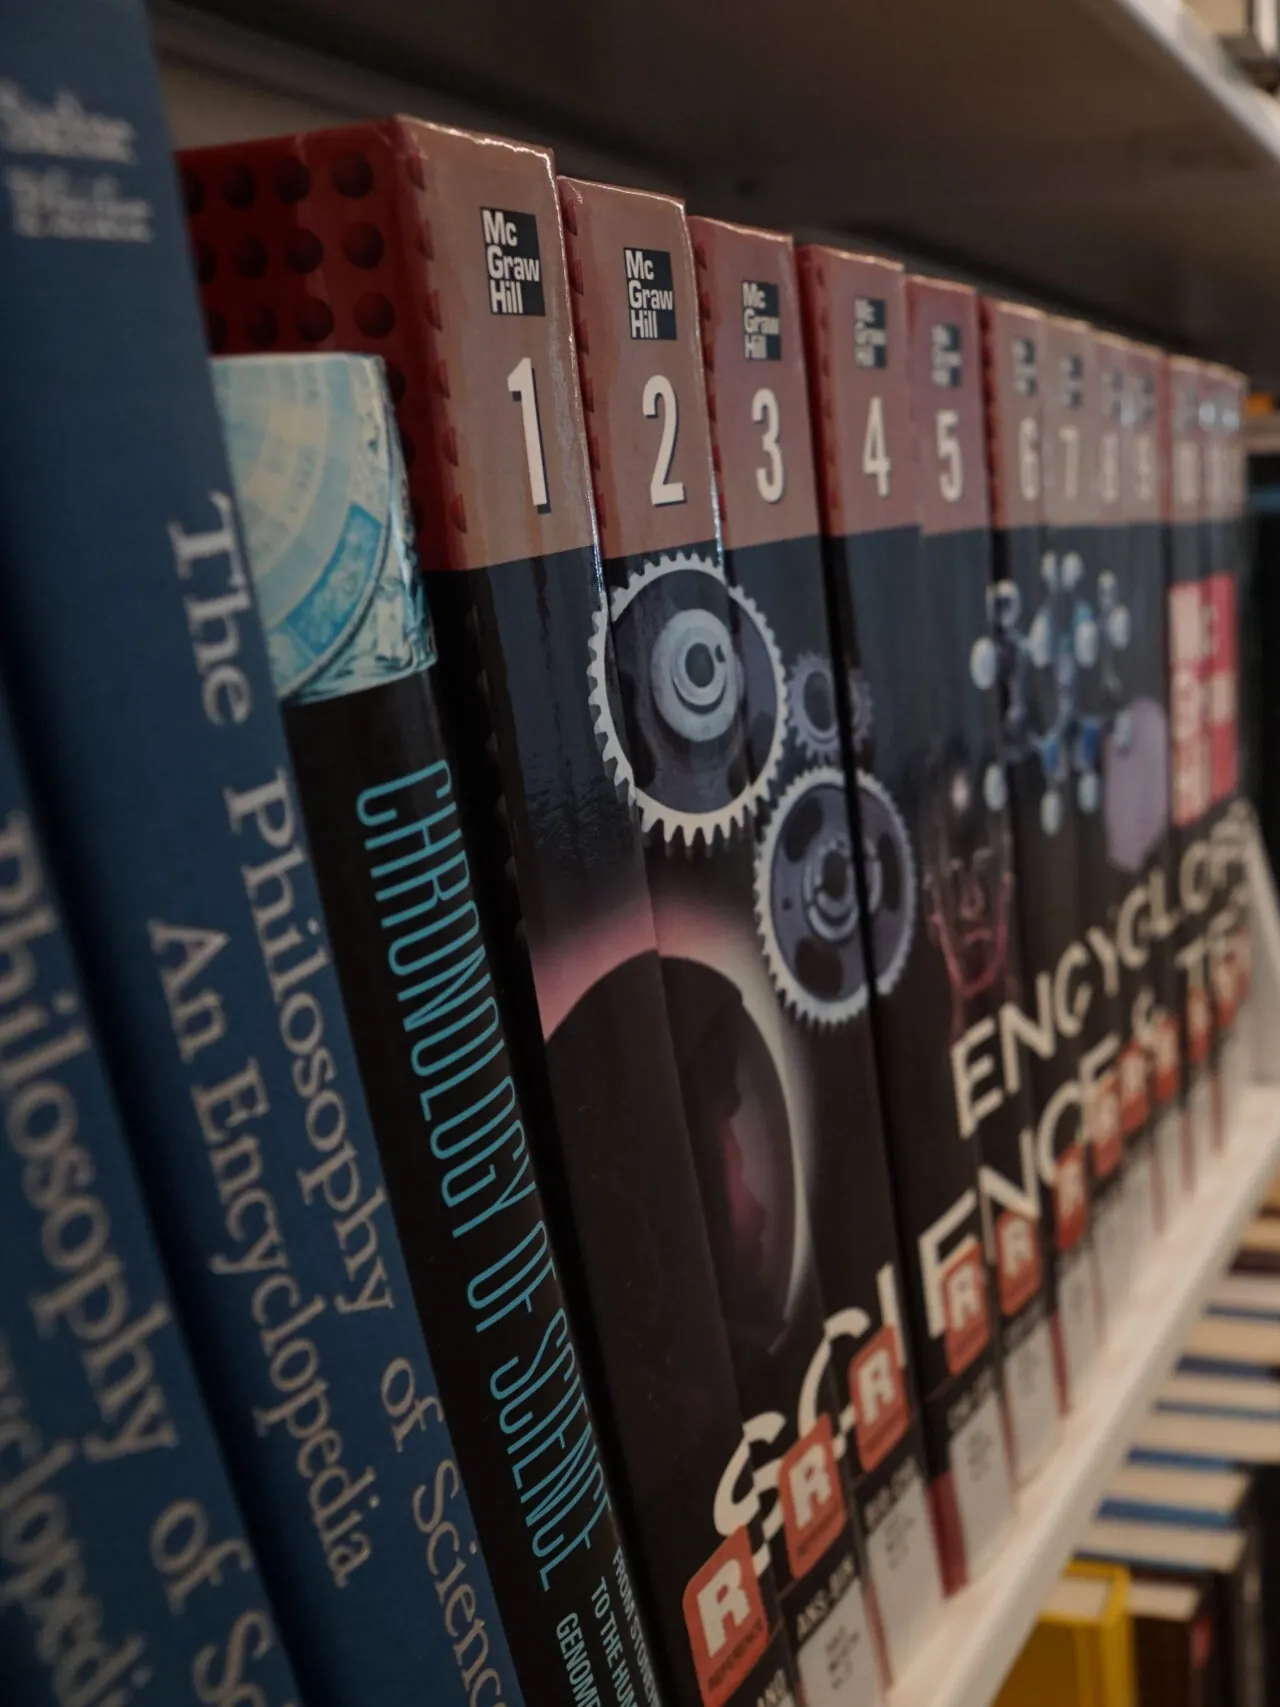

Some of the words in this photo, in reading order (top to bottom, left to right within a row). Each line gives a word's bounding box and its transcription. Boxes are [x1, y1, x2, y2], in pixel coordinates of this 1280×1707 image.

[482, 209, 518, 246] Mc
[486, 245, 540, 281] Graw
[625, 249, 655, 281] Mc
[490, 278, 523, 314] Hill
[628, 281, 674, 311] Graw
[630, 310, 658, 339] Hill
[507, 356, 549, 512] 1
[642, 374, 686, 507] 2
[751, 388, 785, 503] 3
[862, 396, 891, 498] 4
[935, 410, 963, 502] 5
[1017, 416, 1040, 502] 6
[167, 488, 252, 727] The
[222, 766, 395, 1315] Philosophy
[380, 1357, 444, 1453] of
[356, 758, 537, 1240] CHRONOLOGY
[147, 918, 231, 1064] An
[191, 1056, 381, 1590] Encyclopedia
[467, 1219, 557, 1333] OF
[948, 1263, 980, 1331] R
[857, 1348, 895, 1426] R
[490, 1307, 613, 1593] SCIENCE
[787, 1440, 832, 1530] R
[149, 1498, 255, 1615] of
[591, 1575, 611, 1620] TO
[600, 1610, 624, 1669] THE
[697, 1557, 751, 1659] R
